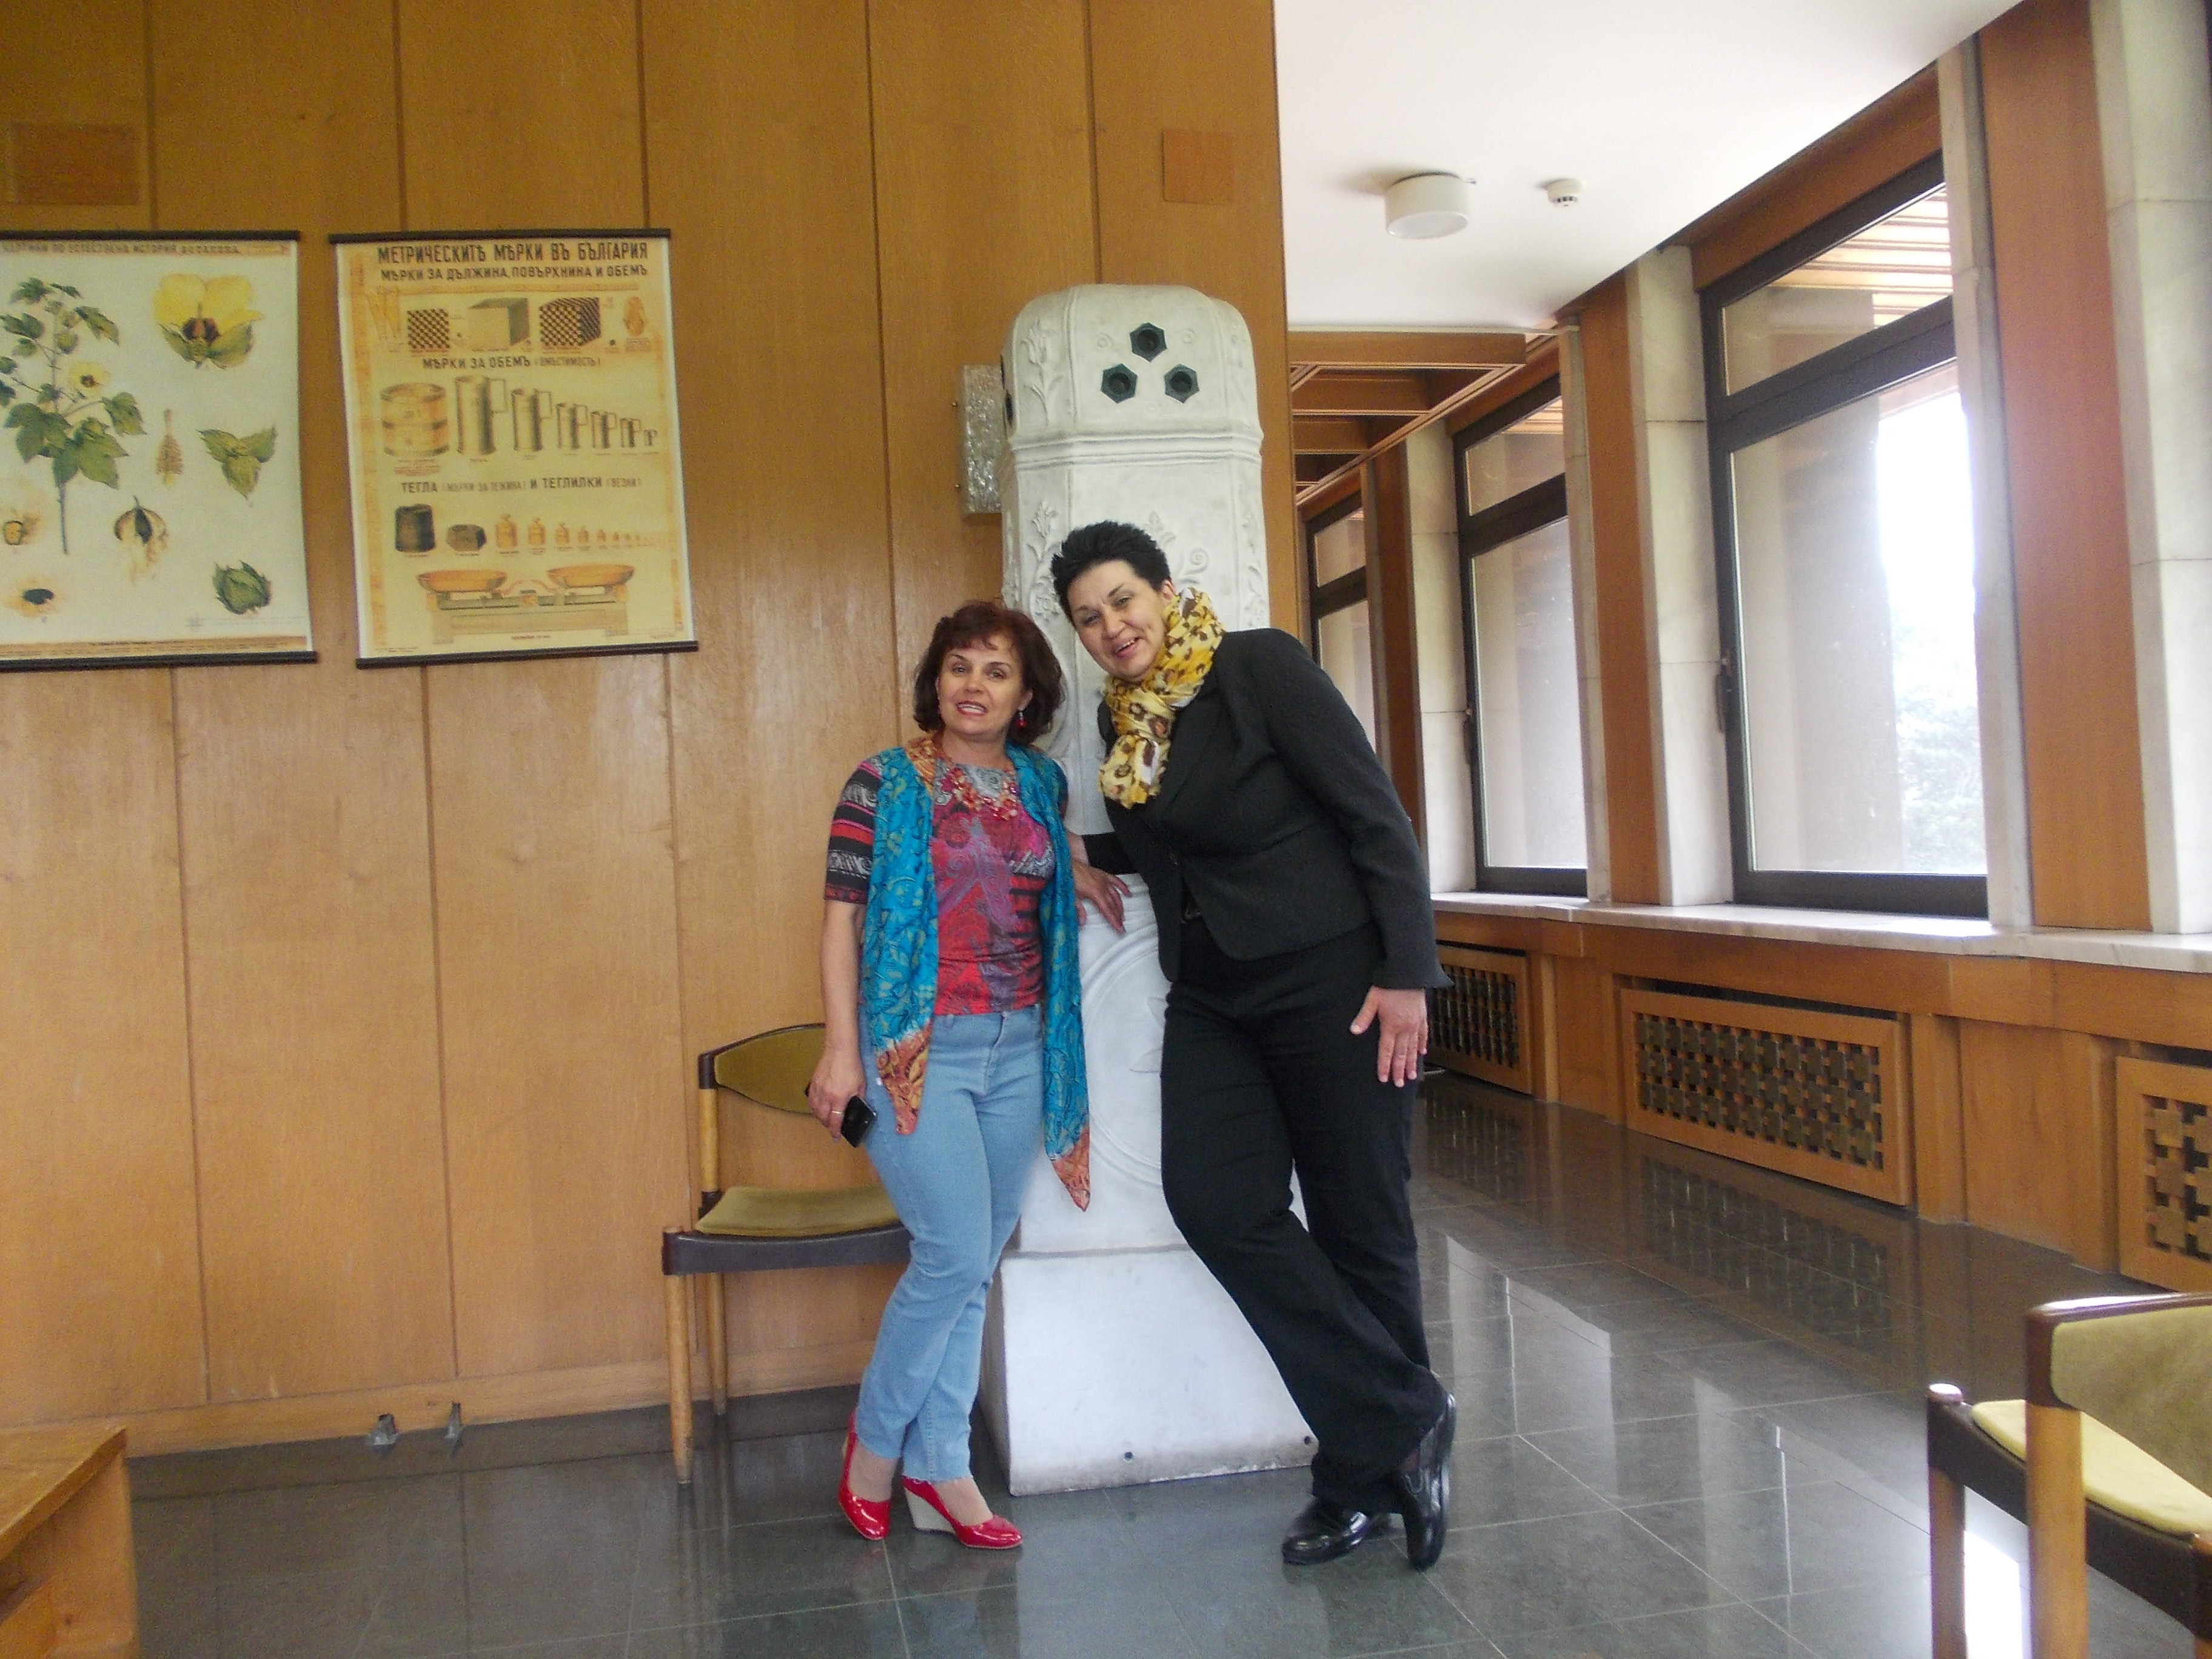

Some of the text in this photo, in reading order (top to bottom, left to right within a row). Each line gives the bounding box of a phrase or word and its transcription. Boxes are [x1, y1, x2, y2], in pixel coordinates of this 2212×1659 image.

[551, 243, 569, 261] ВЪ
[577, 242, 647, 260] БЪЛГАРИЯ
[427, 268, 443, 280] ЗА
[512, 266, 592, 278] ПОВЪРХНИНА
[595, 266, 603, 277] И
[607, 264, 648, 276] ОБЕМЪ
[470, 357, 485, 369] ЗА
[489, 356, 530, 367] ОБЕМЪ
[401, 481, 438, 494] ТЕГЛА
[530, 478, 537, 489] И
[541, 477, 602, 489] ТЕГЛИЛКИ
